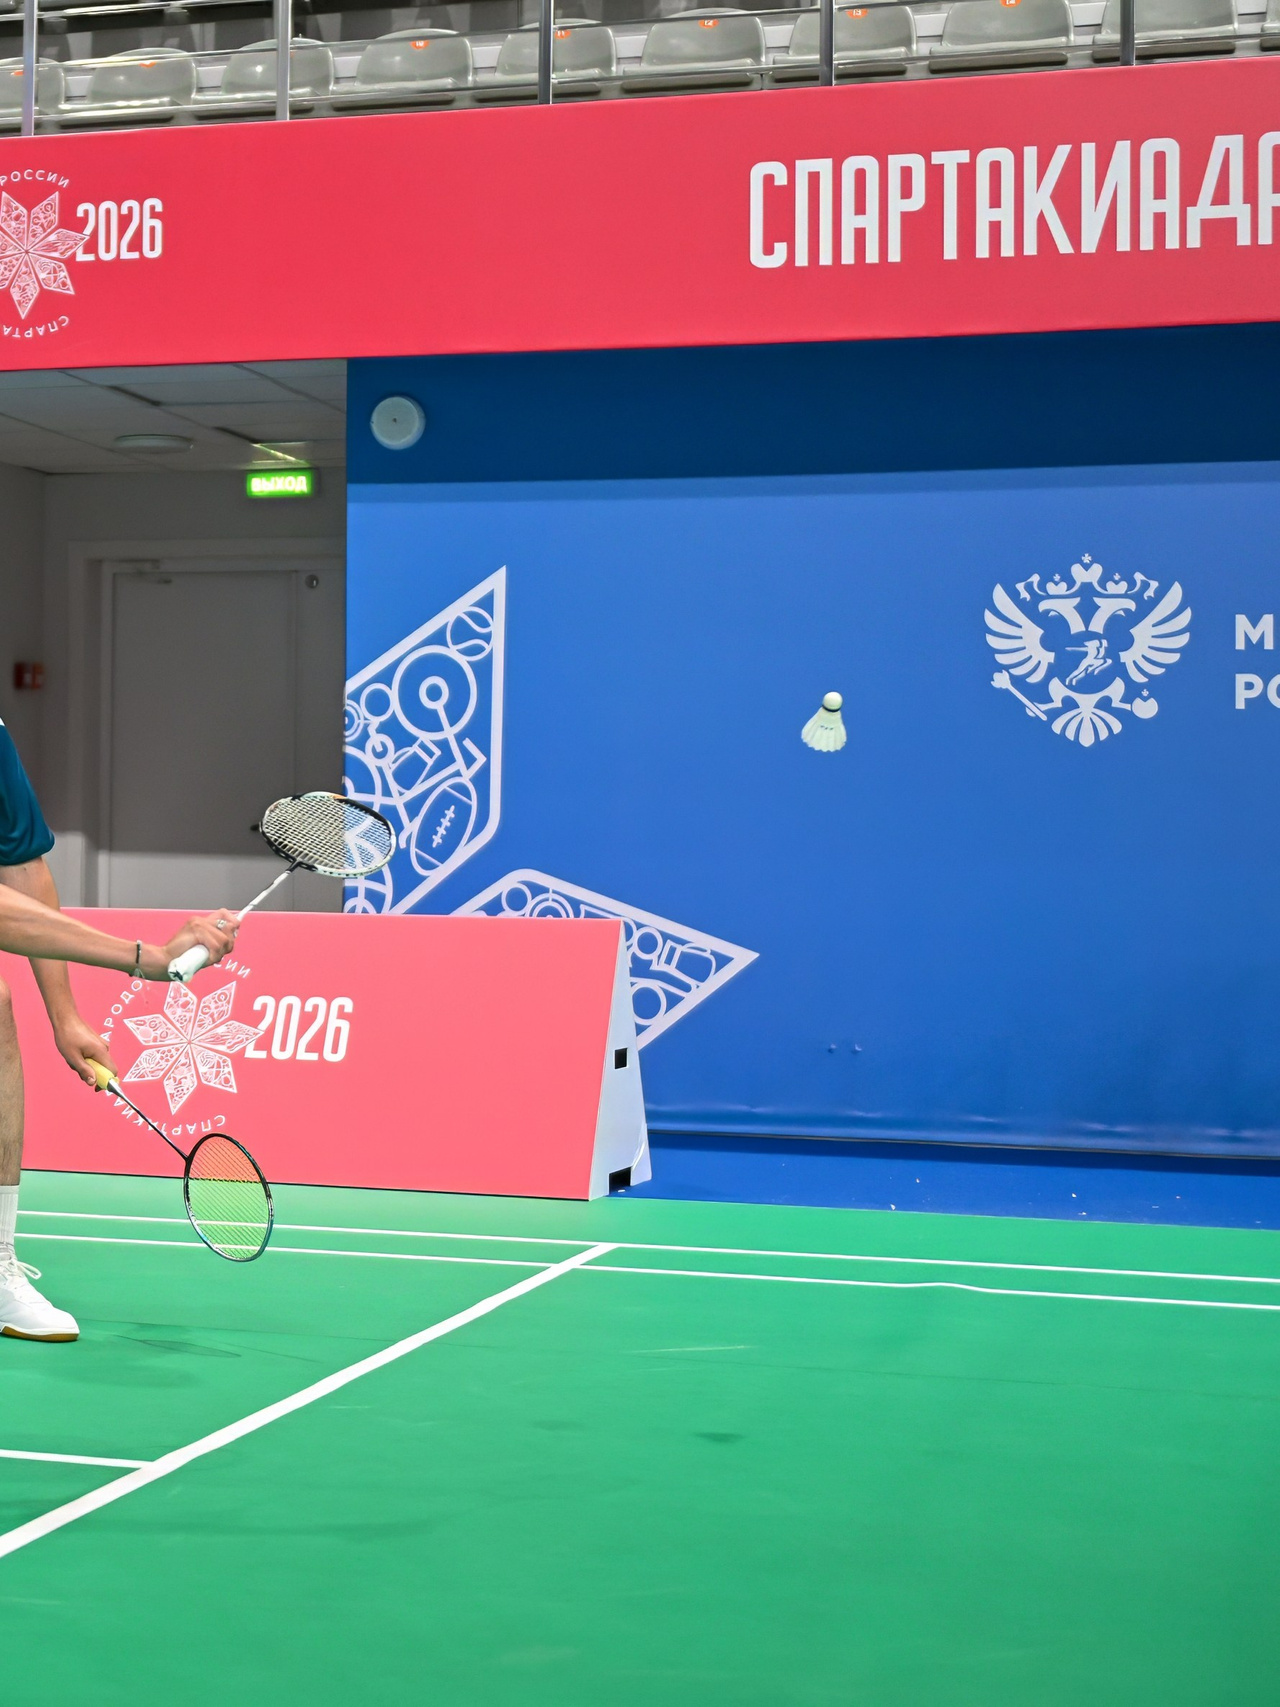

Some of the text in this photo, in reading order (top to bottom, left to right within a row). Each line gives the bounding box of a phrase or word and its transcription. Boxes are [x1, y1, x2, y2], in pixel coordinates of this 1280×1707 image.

[75, 197, 163, 262] 2026
[748, 130, 1280, 269] СПАРТАКИАДА
[251, 475, 308, 494] ВЫХОД
[100, 980, 143, 1042] АРОДО
[244, 995, 353, 1063] 2026
